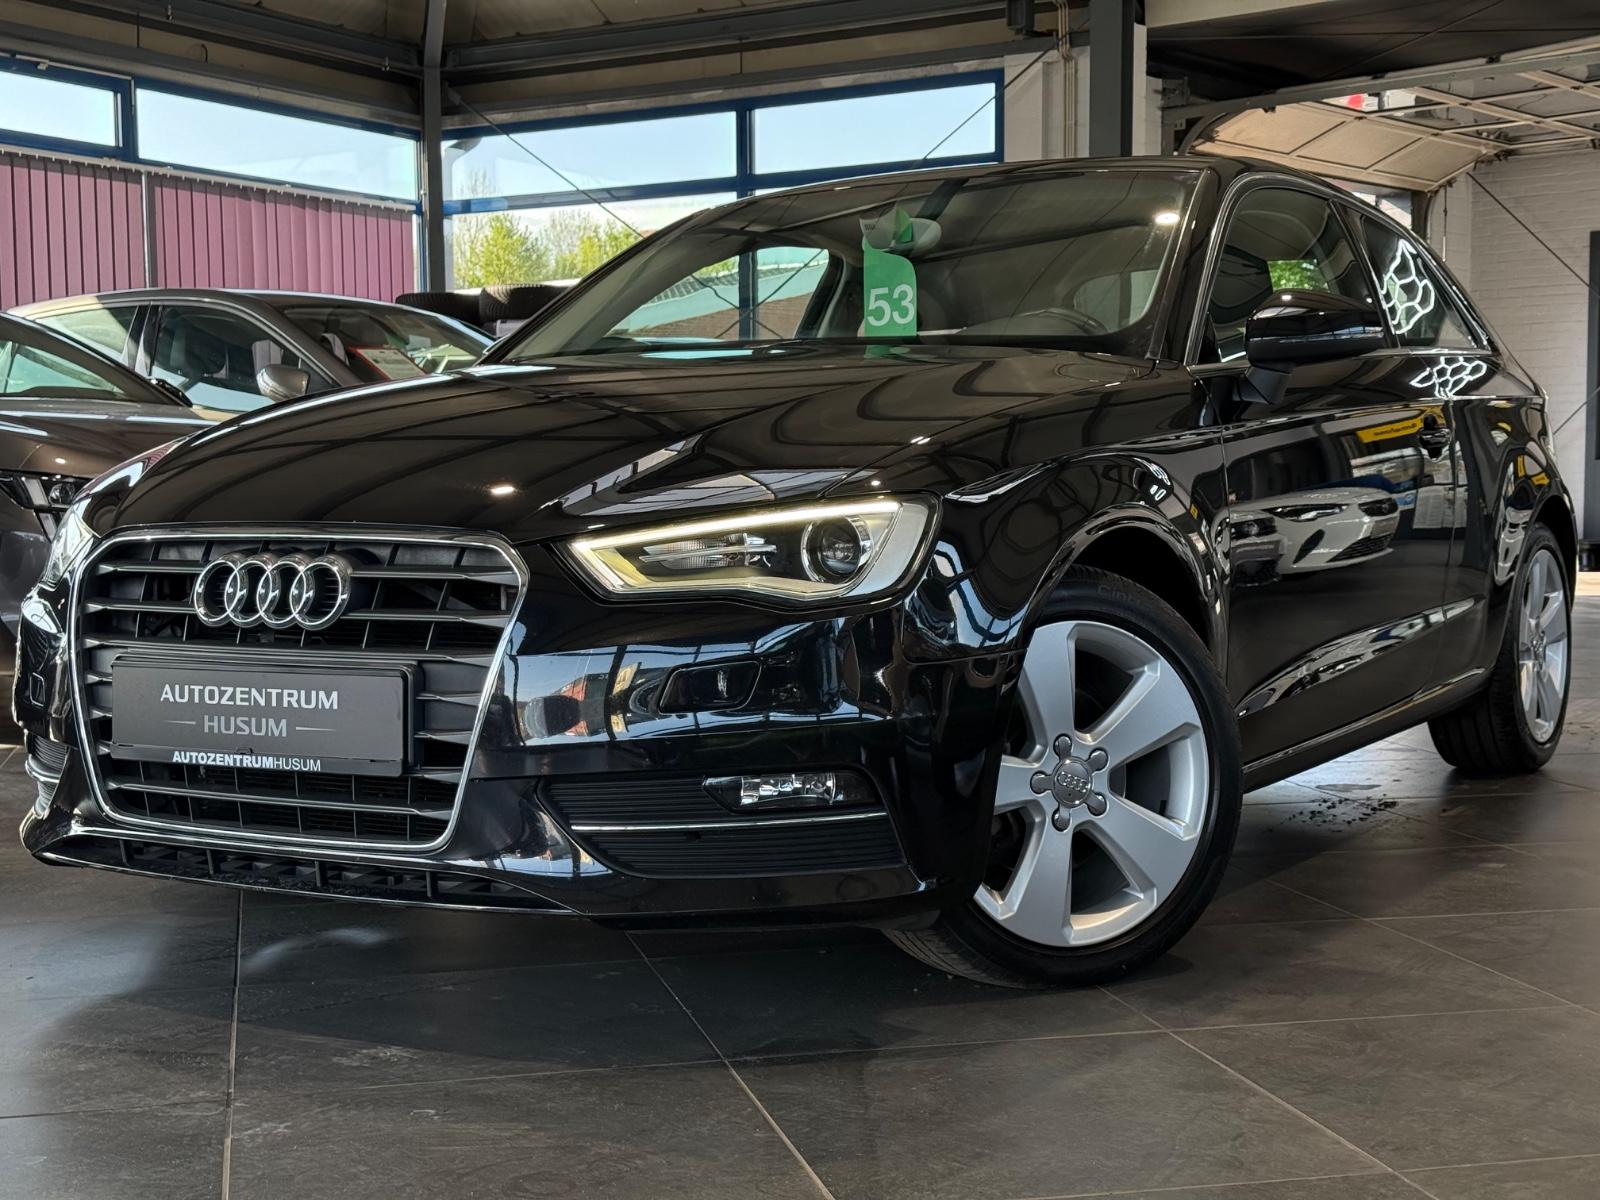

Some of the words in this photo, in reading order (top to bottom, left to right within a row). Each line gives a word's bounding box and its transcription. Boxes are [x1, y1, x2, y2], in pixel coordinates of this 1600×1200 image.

[867, 284, 915, 327] 53
[160, 683, 338, 710] AUTOZENTRUM
[203, 714, 287, 738] HUSUM
[172, 750, 321, 772] AUTOZENTRUMHUSUM
